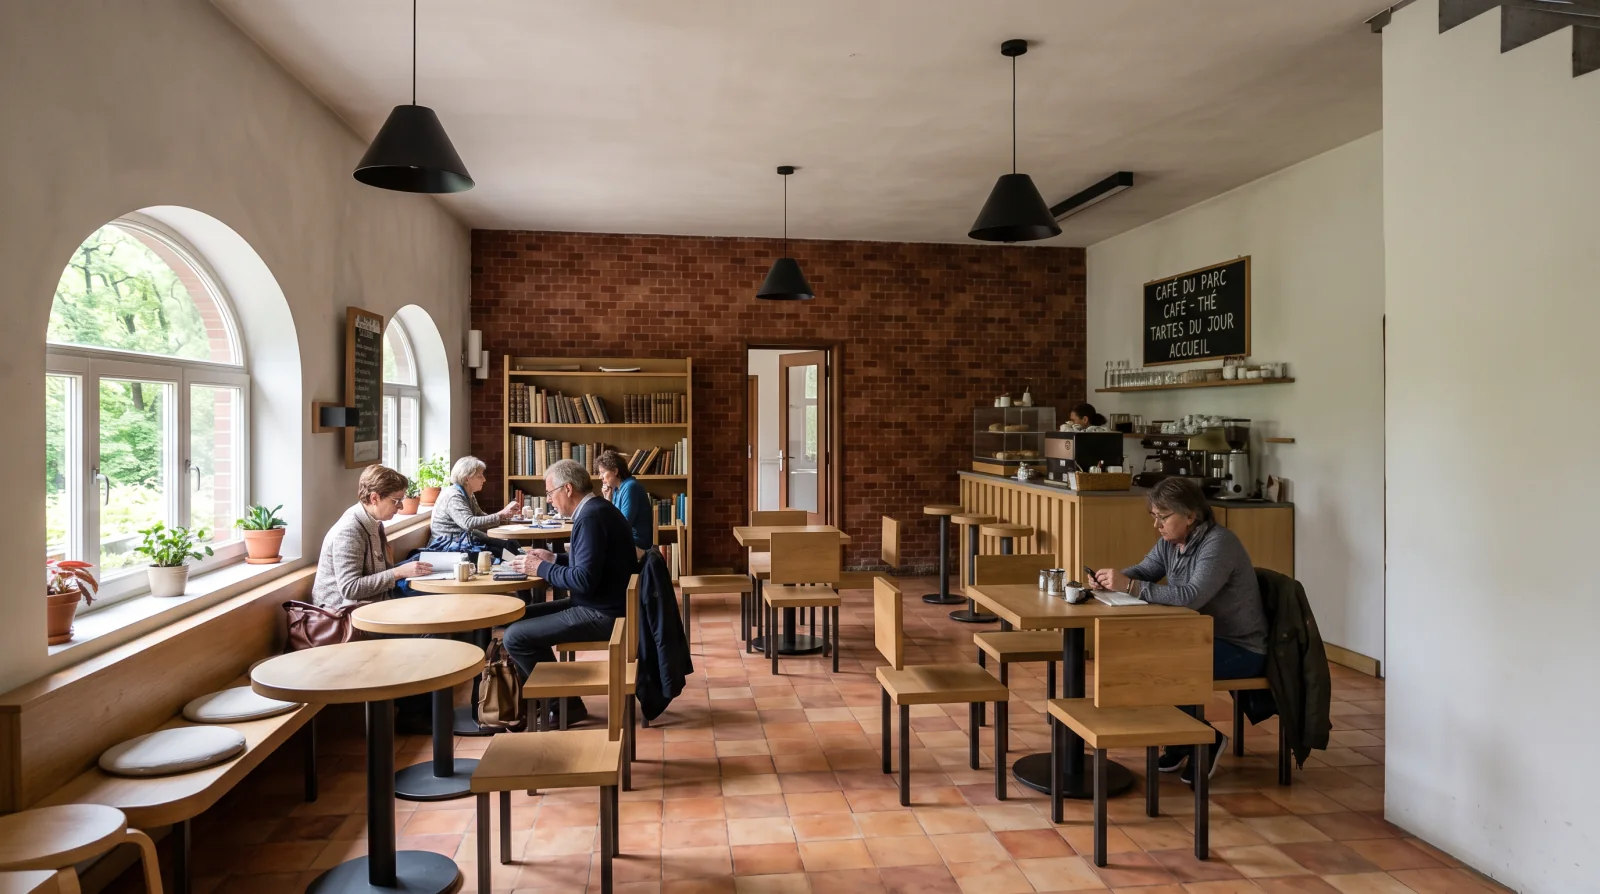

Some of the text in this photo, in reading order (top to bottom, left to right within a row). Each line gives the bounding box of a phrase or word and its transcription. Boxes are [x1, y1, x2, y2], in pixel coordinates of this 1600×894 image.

[1156, 269, 1227, 301] CAFÉ DU PARC
[1164, 296, 1186, 319] CAFÉ
[1198, 289, 1217, 312] THÉ
[1150, 312, 1234, 341] TARTES DU JOUR
[1169, 338, 1210, 358] ACCUEIL
